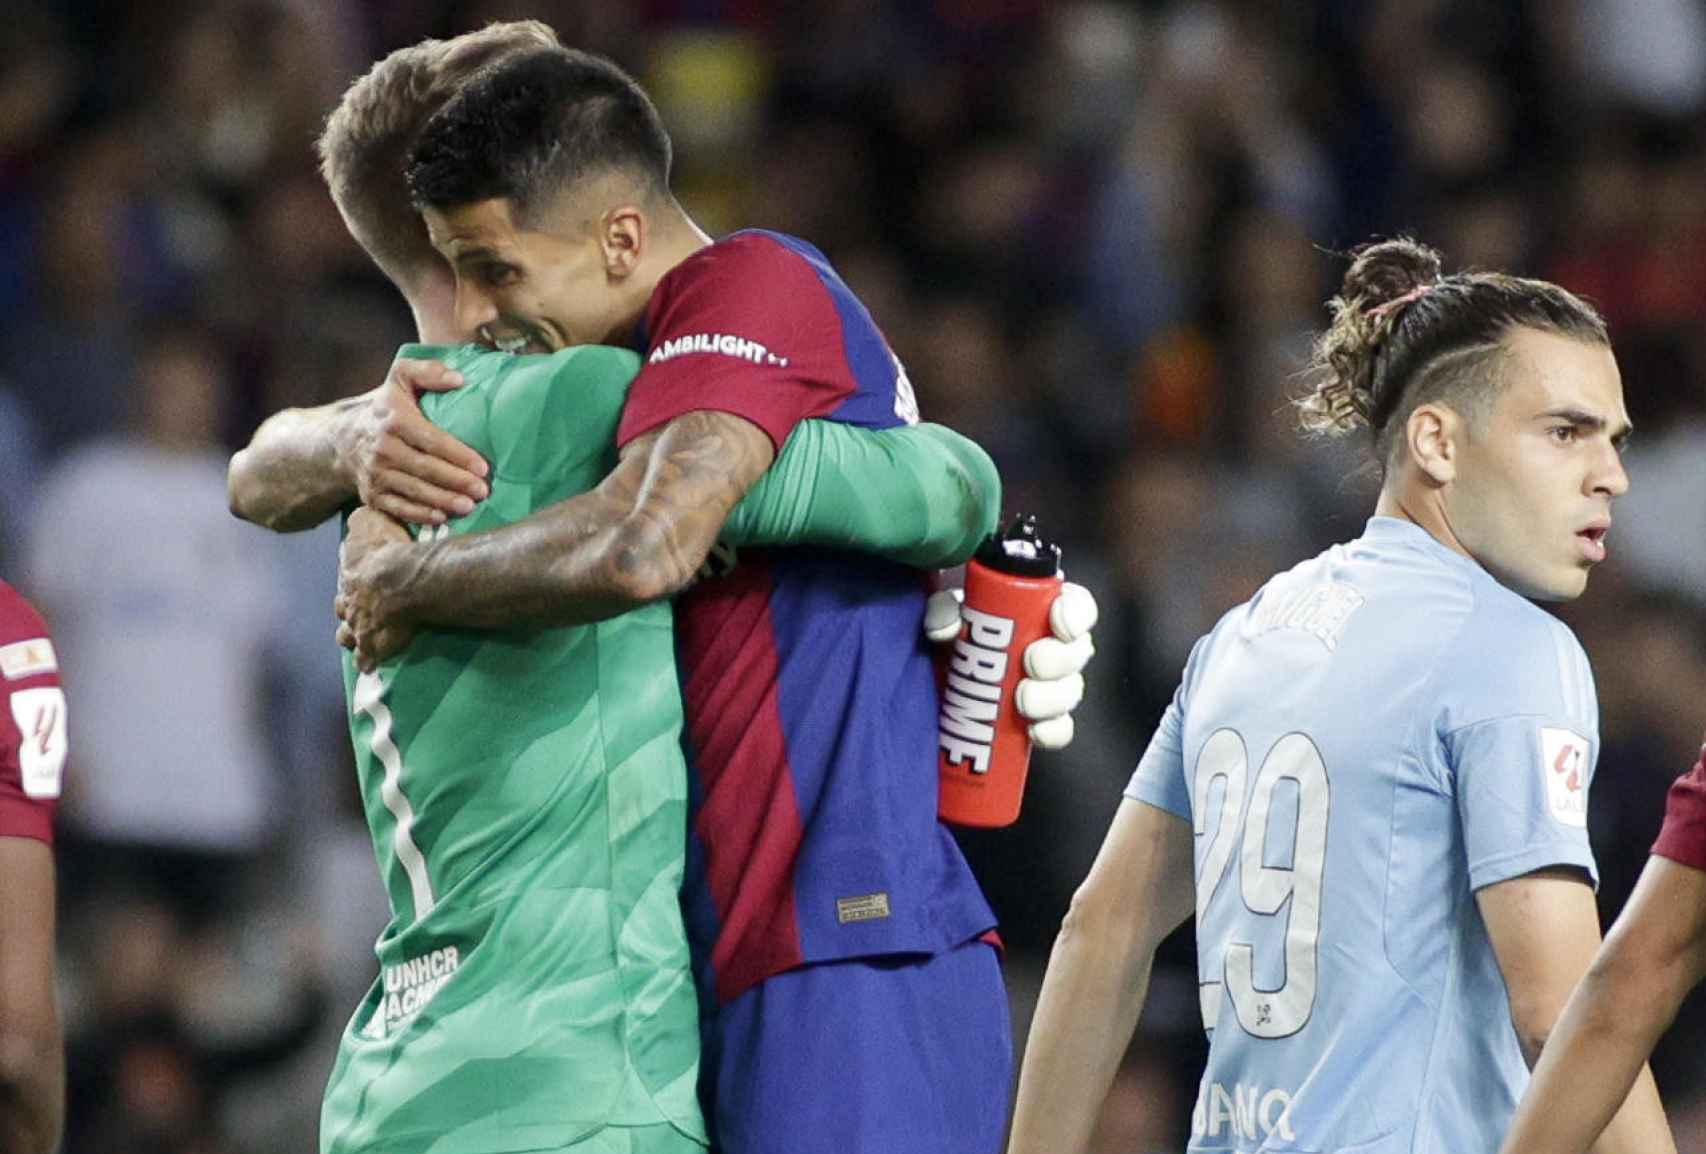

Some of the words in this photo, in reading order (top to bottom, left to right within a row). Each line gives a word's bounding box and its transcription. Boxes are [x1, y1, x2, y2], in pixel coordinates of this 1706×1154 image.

[649, 333, 767, 365] AMBILIGHT
[940, 606, 1014, 774] PRIME
[1194, 727, 1330, 1038] 29
[386, 945, 458, 992] UNHCR
